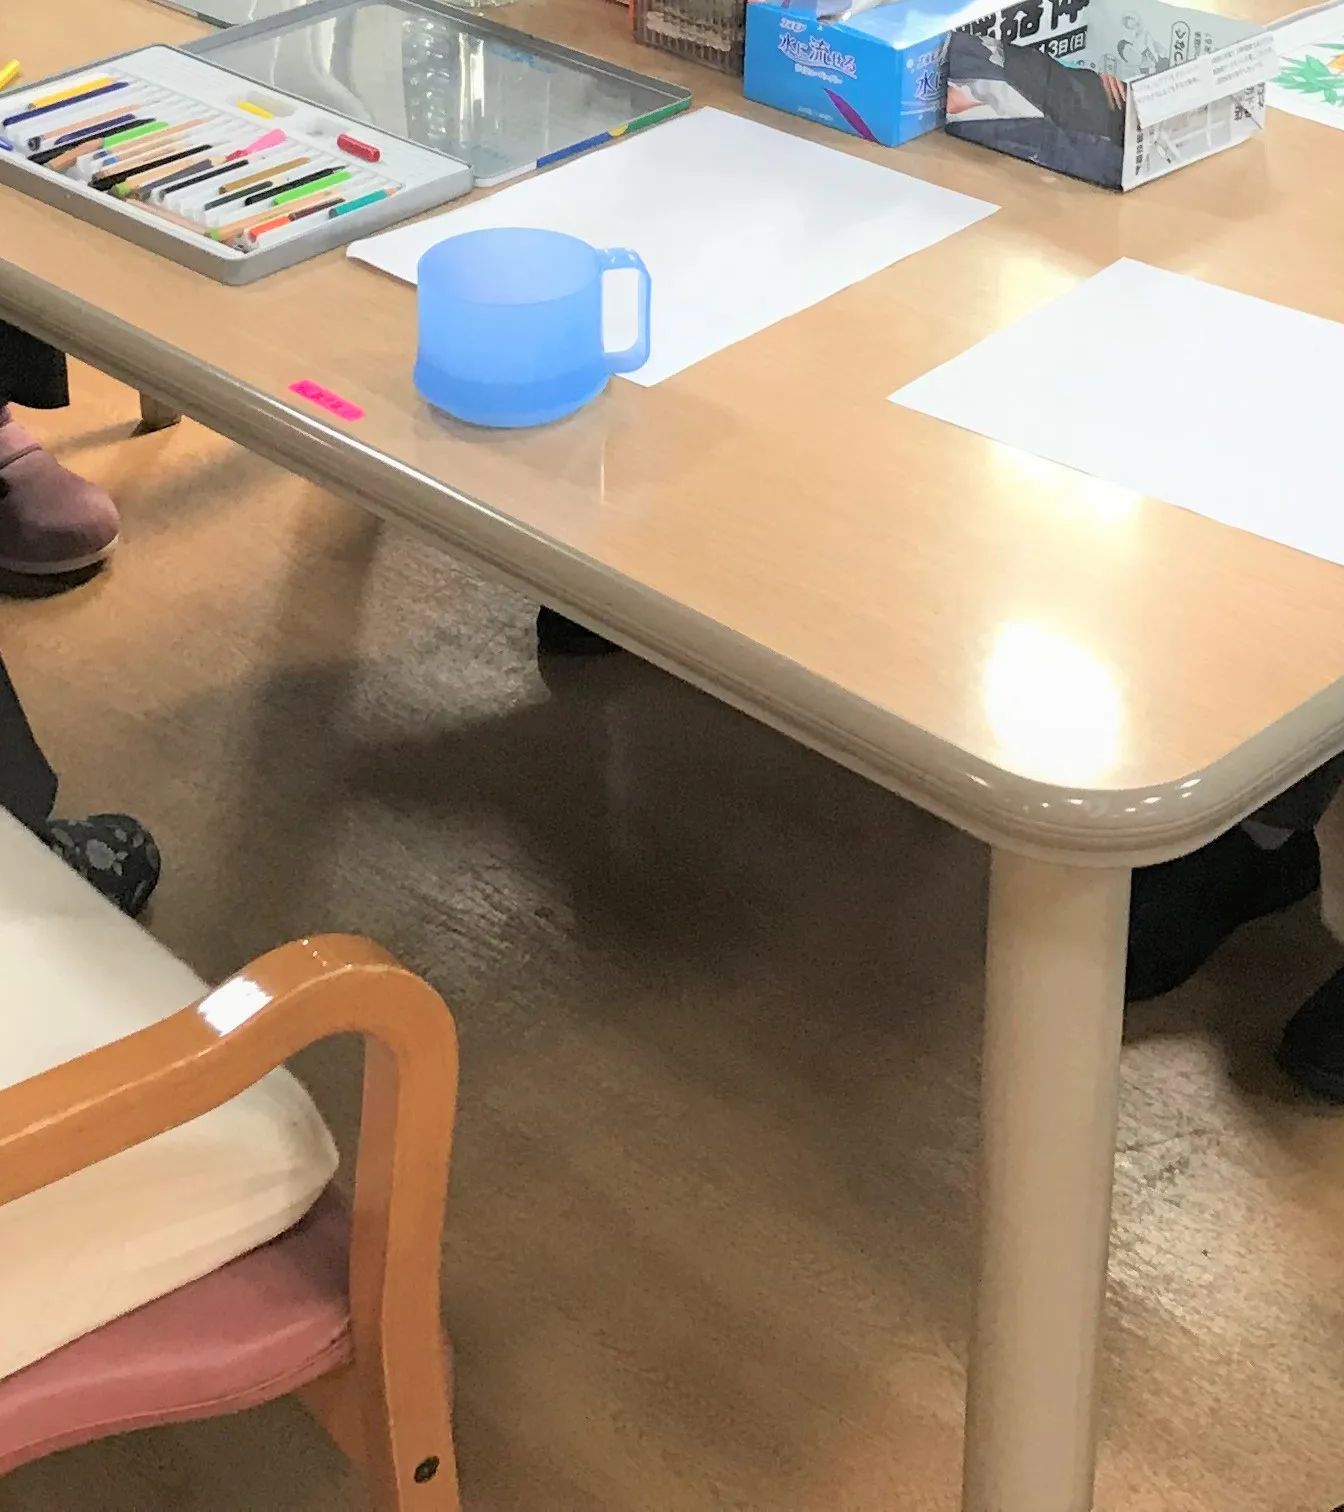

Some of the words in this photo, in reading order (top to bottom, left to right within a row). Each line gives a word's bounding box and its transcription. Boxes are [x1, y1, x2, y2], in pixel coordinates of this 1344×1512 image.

[778, 32, 857, 75] 水に流せる
